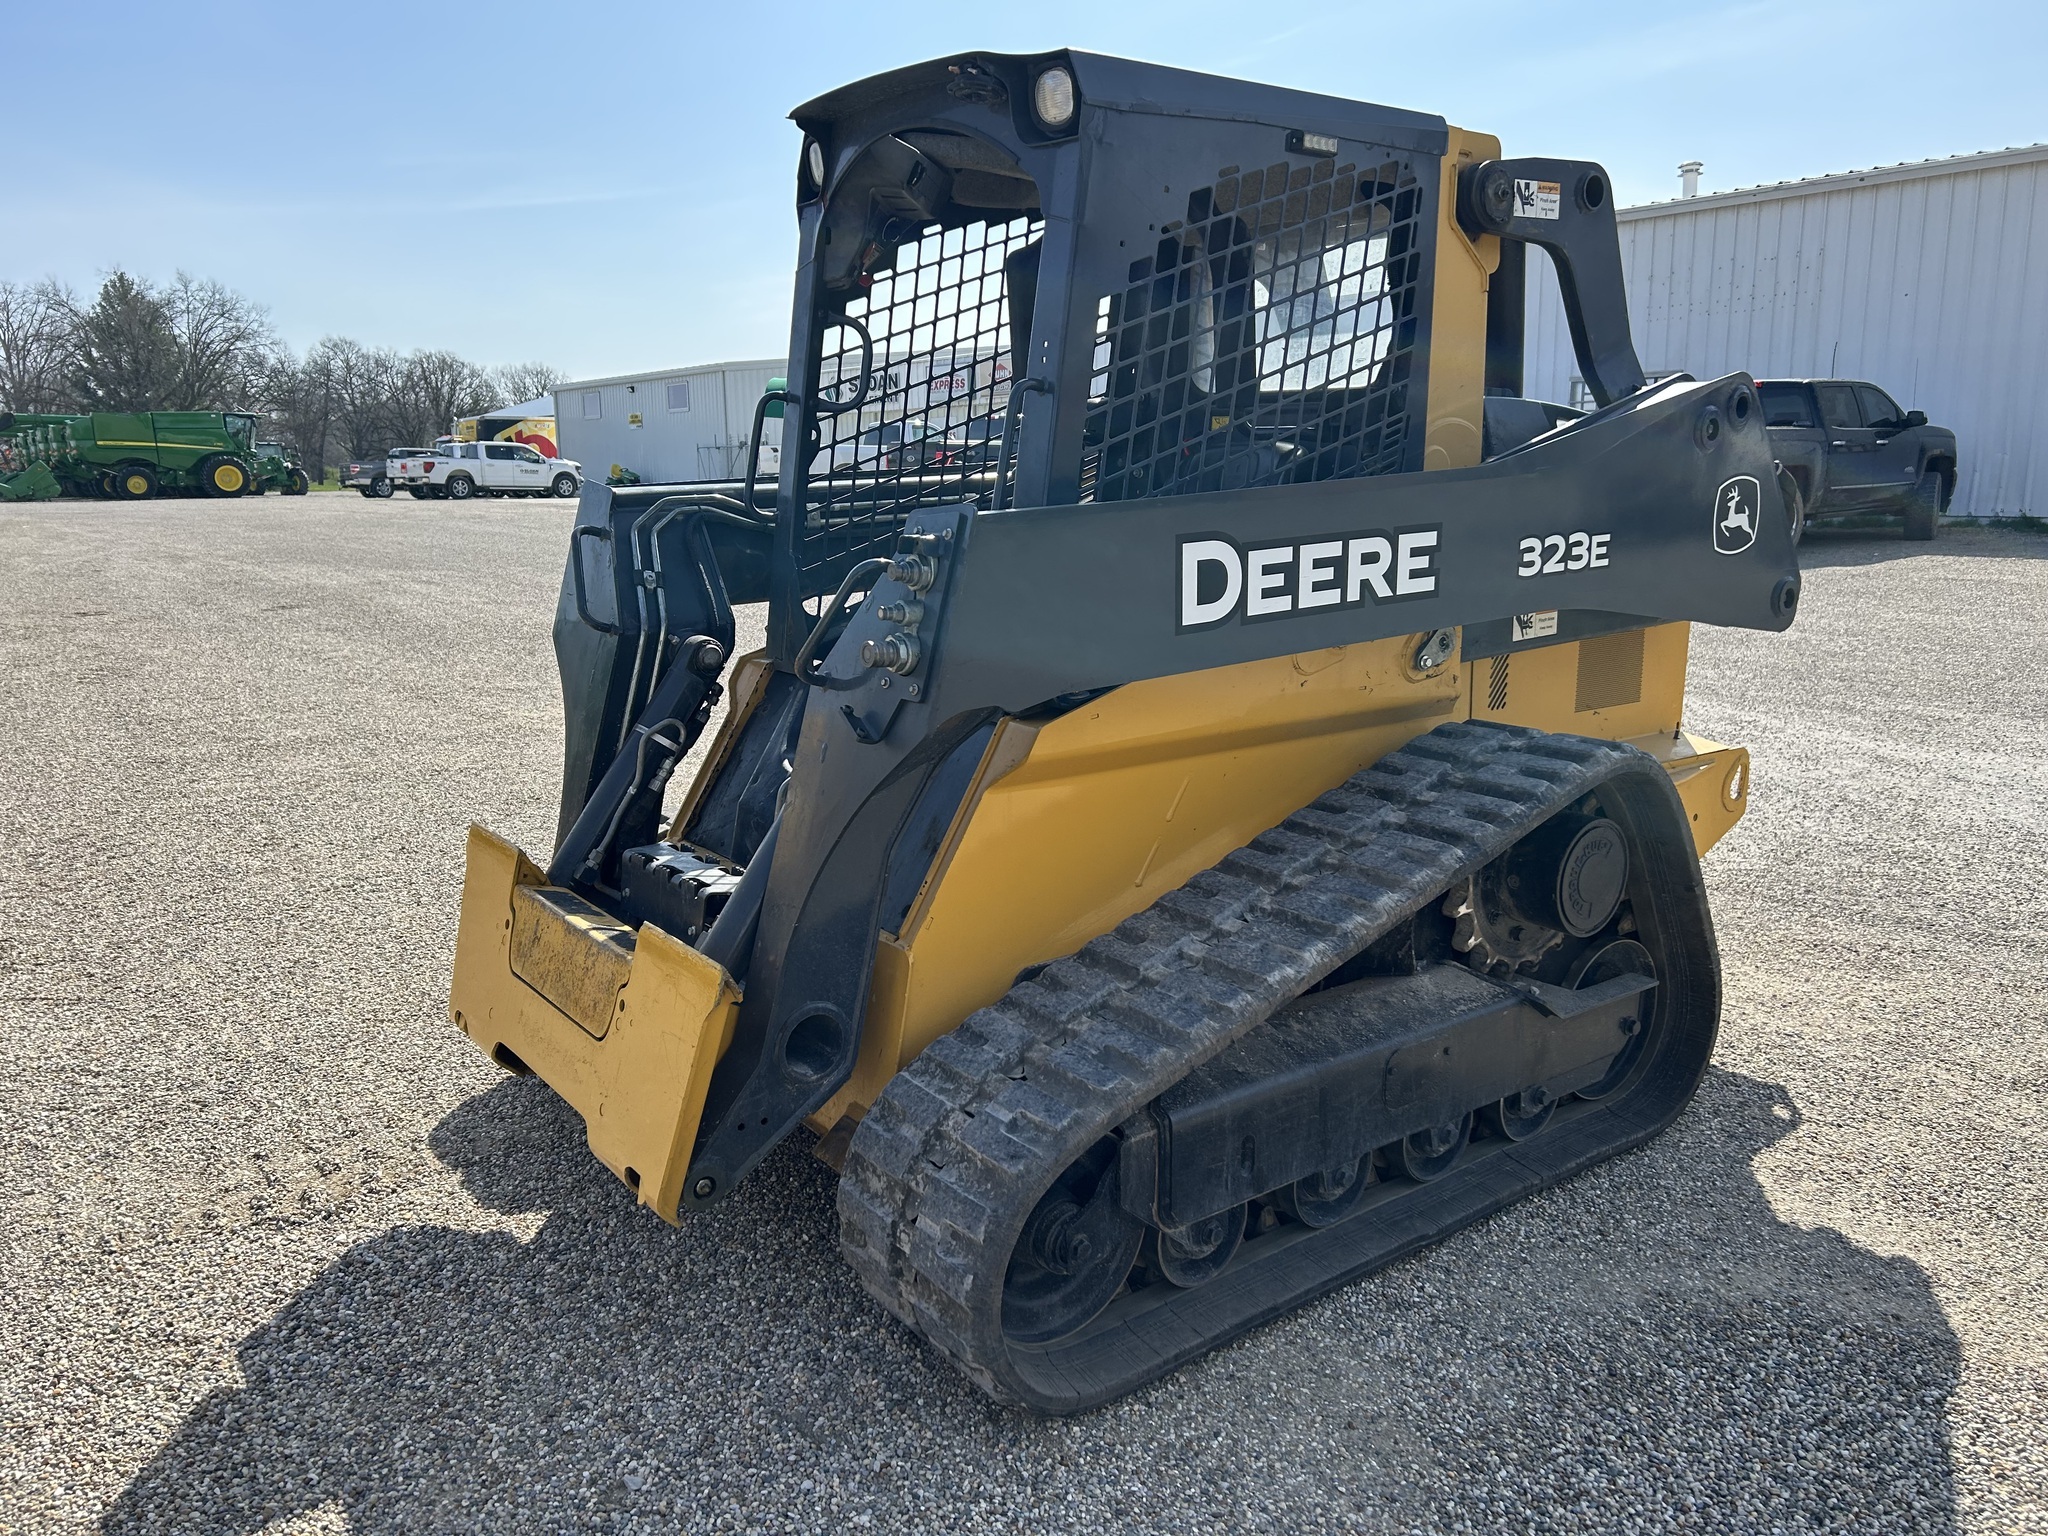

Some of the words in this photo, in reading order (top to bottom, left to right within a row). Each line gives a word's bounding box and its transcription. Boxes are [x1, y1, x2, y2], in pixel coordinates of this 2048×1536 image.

[848, 373, 898, 392] SOAN
[1518, 531, 1611, 577] 323E
[1182, 531, 1438, 626] DEERE
